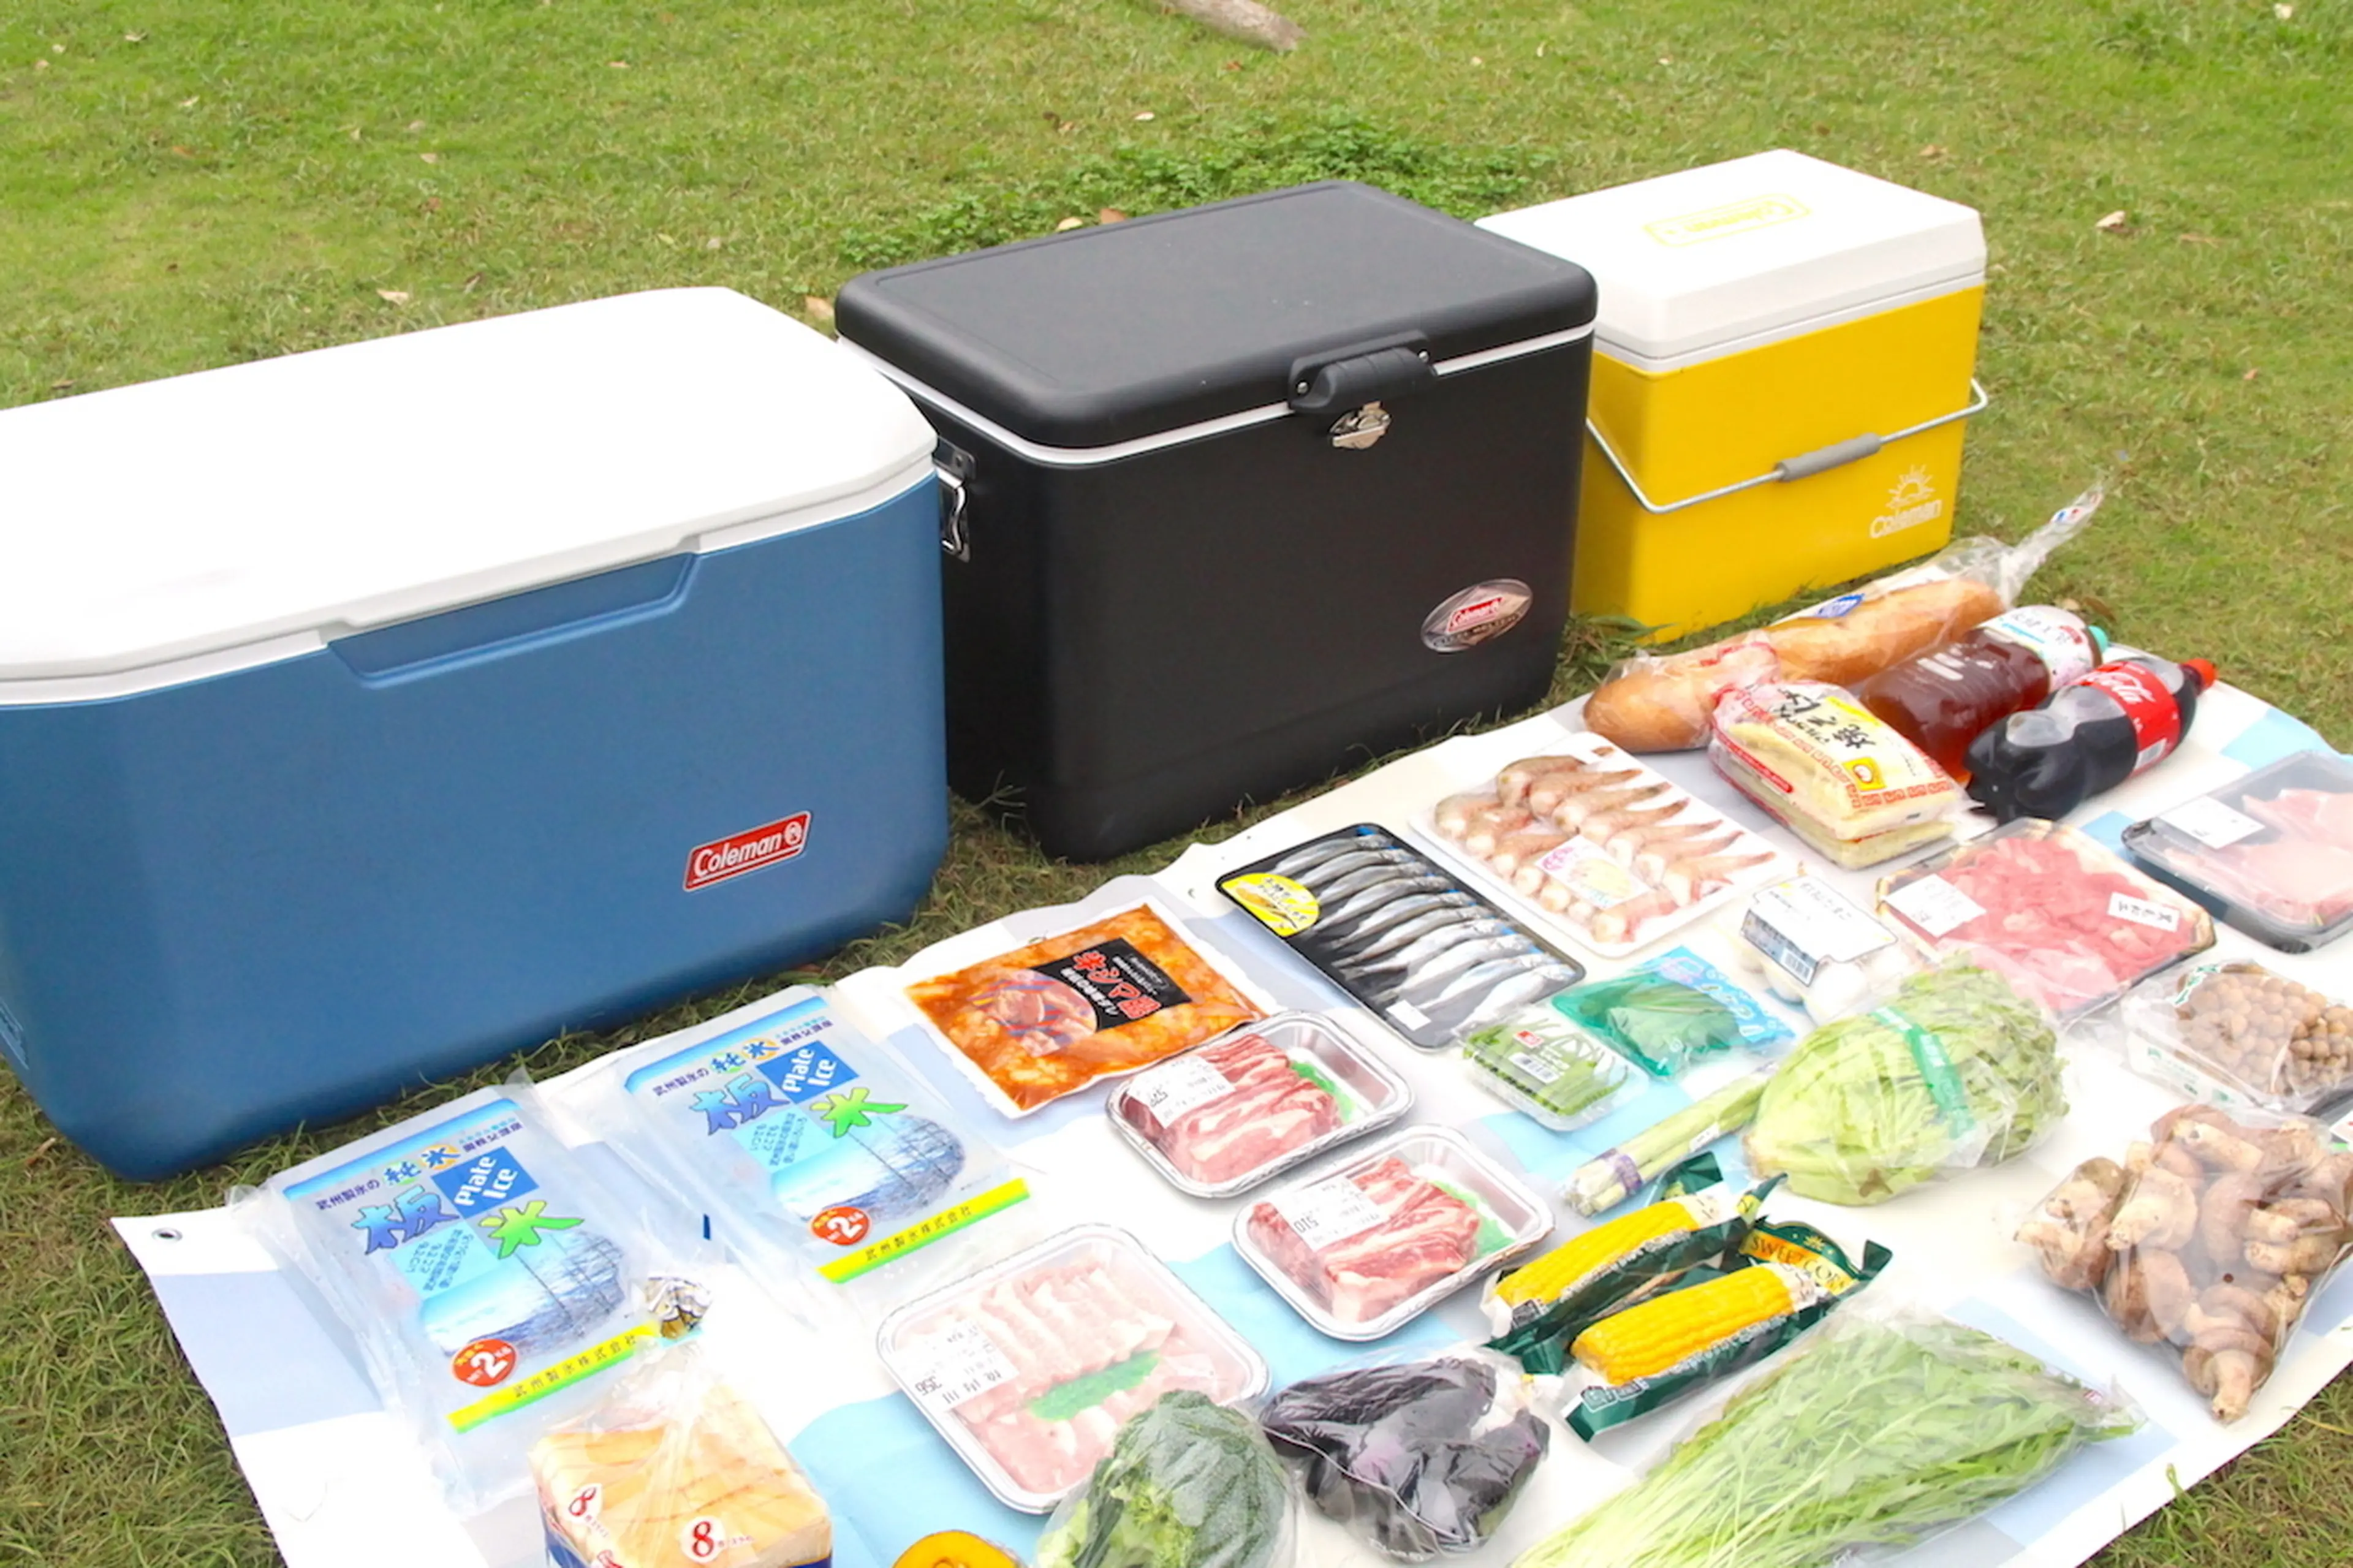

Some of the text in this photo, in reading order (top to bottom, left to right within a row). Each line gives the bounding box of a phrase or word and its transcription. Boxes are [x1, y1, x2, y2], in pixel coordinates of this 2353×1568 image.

[1870, 499, 1942, 539] Coleman
[694, 832, 782, 878] Coleman
[782, 1048, 815, 1093] Plate
[807, 1059, 837, 1086] Ice
[453, 1156, 498, 1206] Plate
[482, 1168, 519, 1199] Ice
[1752, 1235, 1803, 1262] SWEET
[568, 1487, 597, 1517] 8
[692, 1520, 714, 1558] 8
